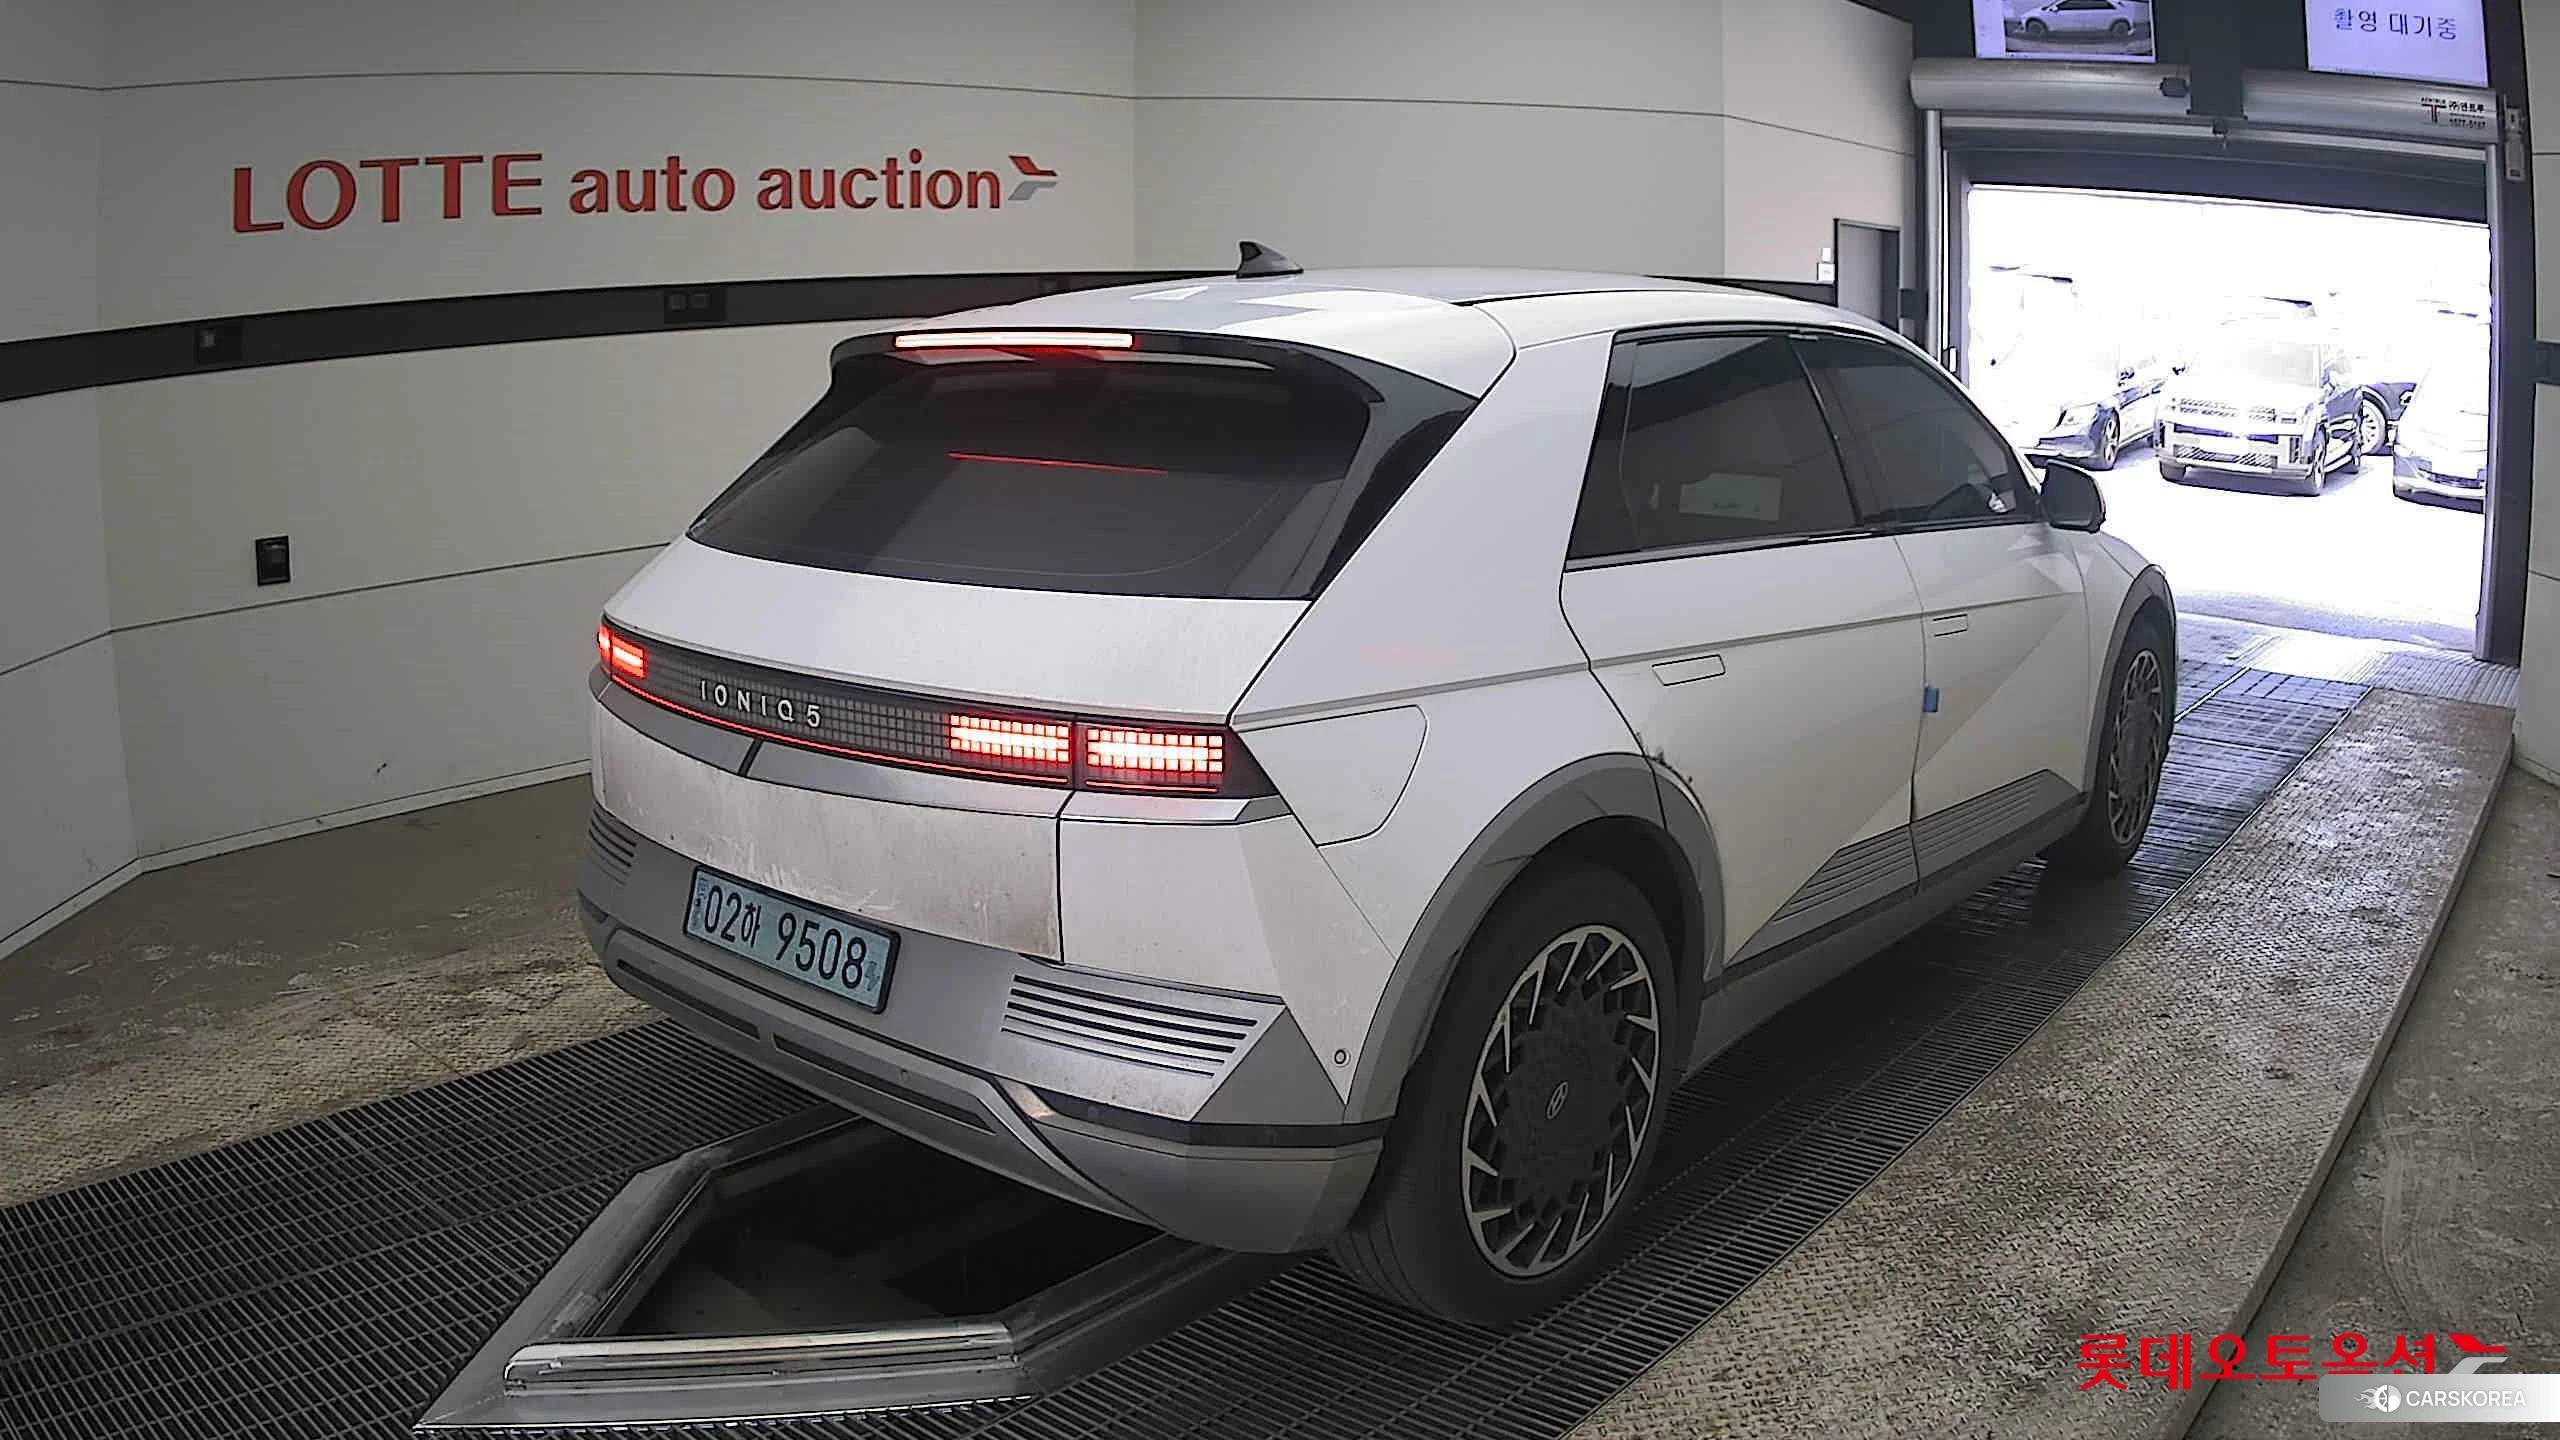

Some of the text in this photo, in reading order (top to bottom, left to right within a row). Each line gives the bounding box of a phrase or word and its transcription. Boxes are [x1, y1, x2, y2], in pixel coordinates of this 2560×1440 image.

[2335, 8, 2457, 40] 촬영 대기중
[233, 148, 1002, 233] LOTTE auto auction
[704, 885, 762, 949] 02하
[775, 912, 867, 989] 9508
